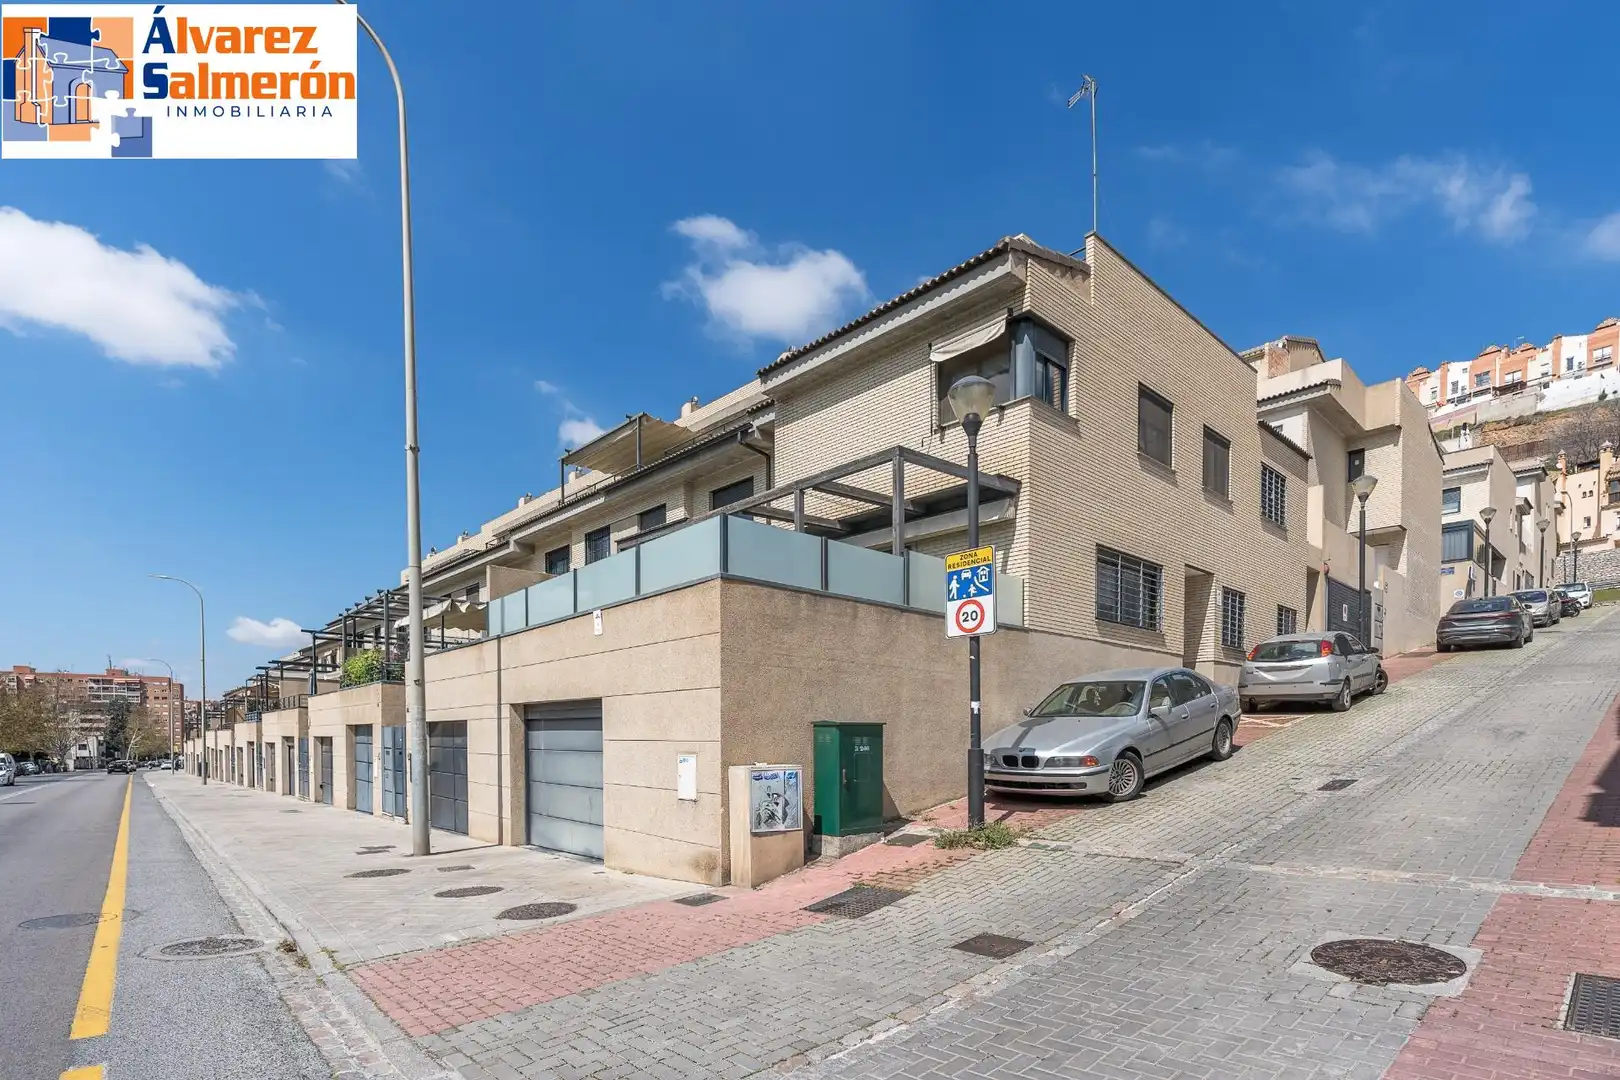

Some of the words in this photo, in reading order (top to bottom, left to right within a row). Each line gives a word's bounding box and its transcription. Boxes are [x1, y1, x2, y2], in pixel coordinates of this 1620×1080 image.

[959, 551, 978, 560] ZONA
[947, 555, 991, 570] RESIDENCIAL
[961, 610, 978, 623] 20
